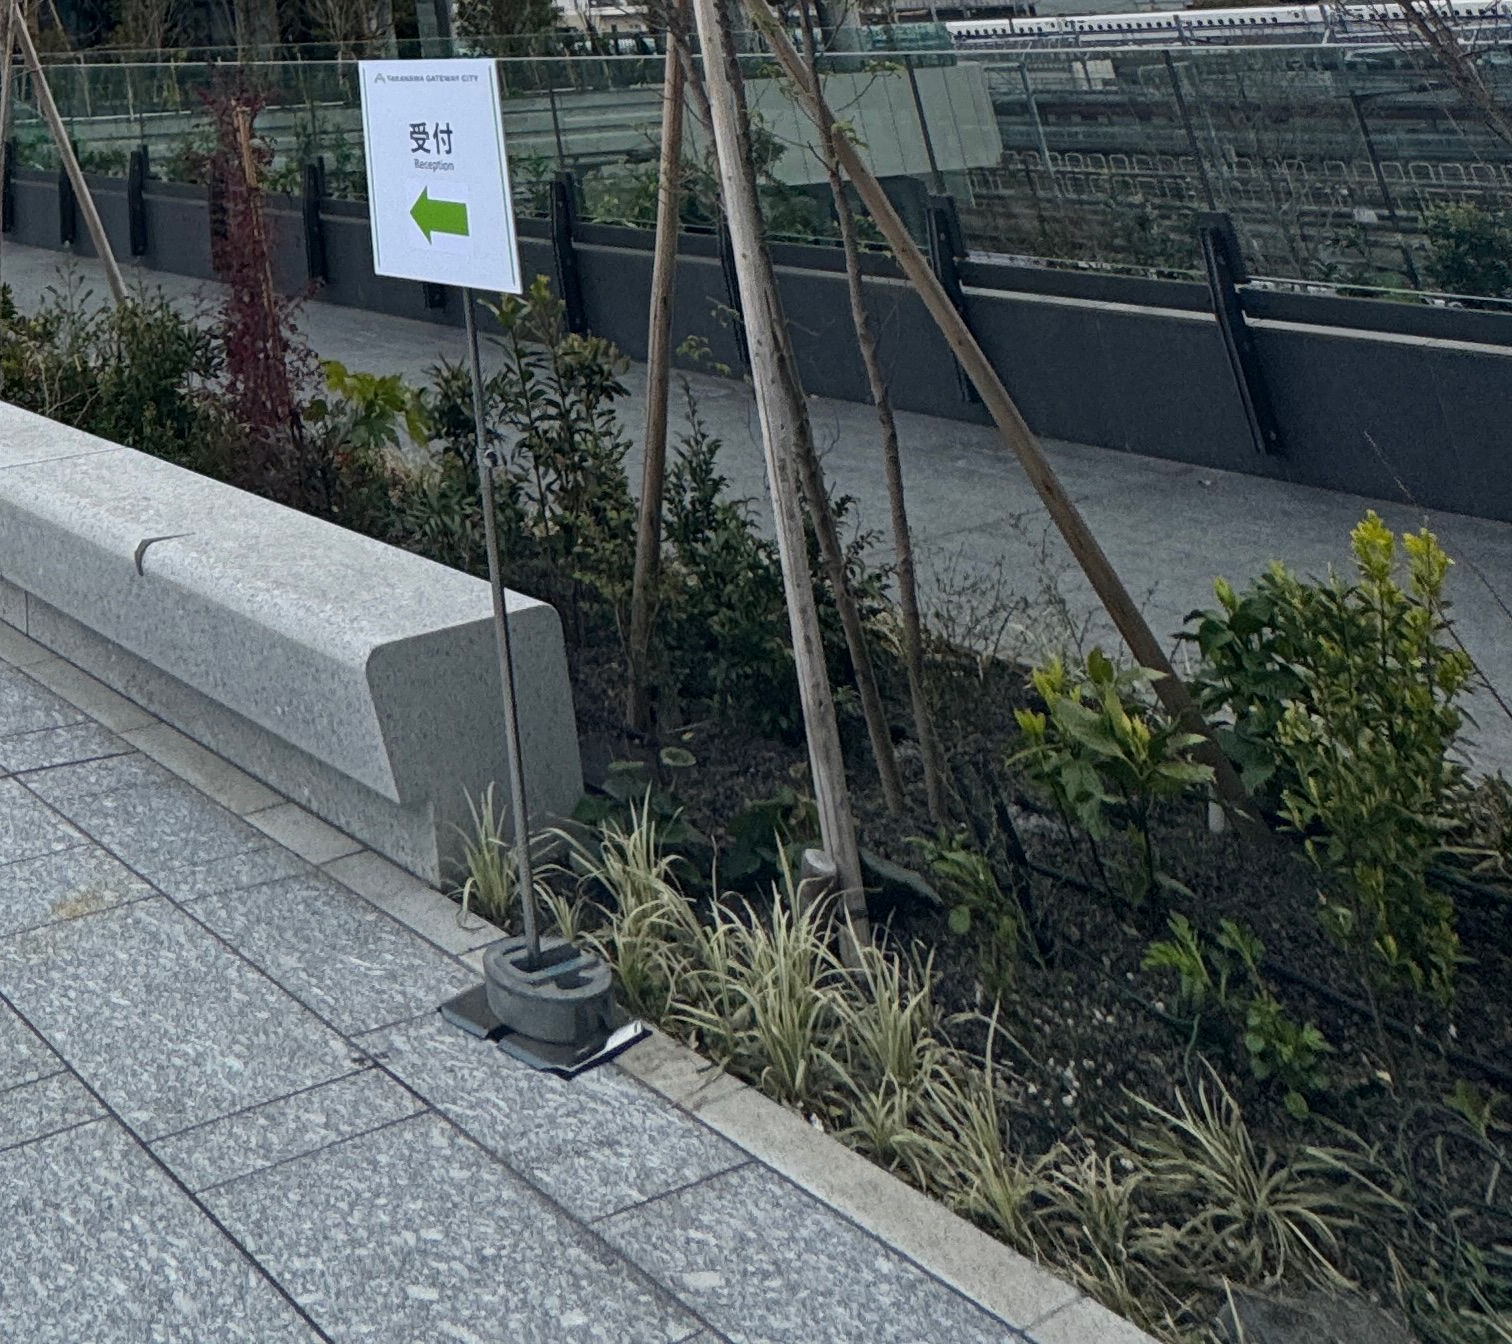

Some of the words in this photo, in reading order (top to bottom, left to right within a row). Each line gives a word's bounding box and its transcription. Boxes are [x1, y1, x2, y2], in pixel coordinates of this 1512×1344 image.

[426, 74, 459, 82] GATEWAY
[461, 74, 478, 82] CITY
[409, 122, 453, 155] 受付
[414, 158, 454, 172] Reception
